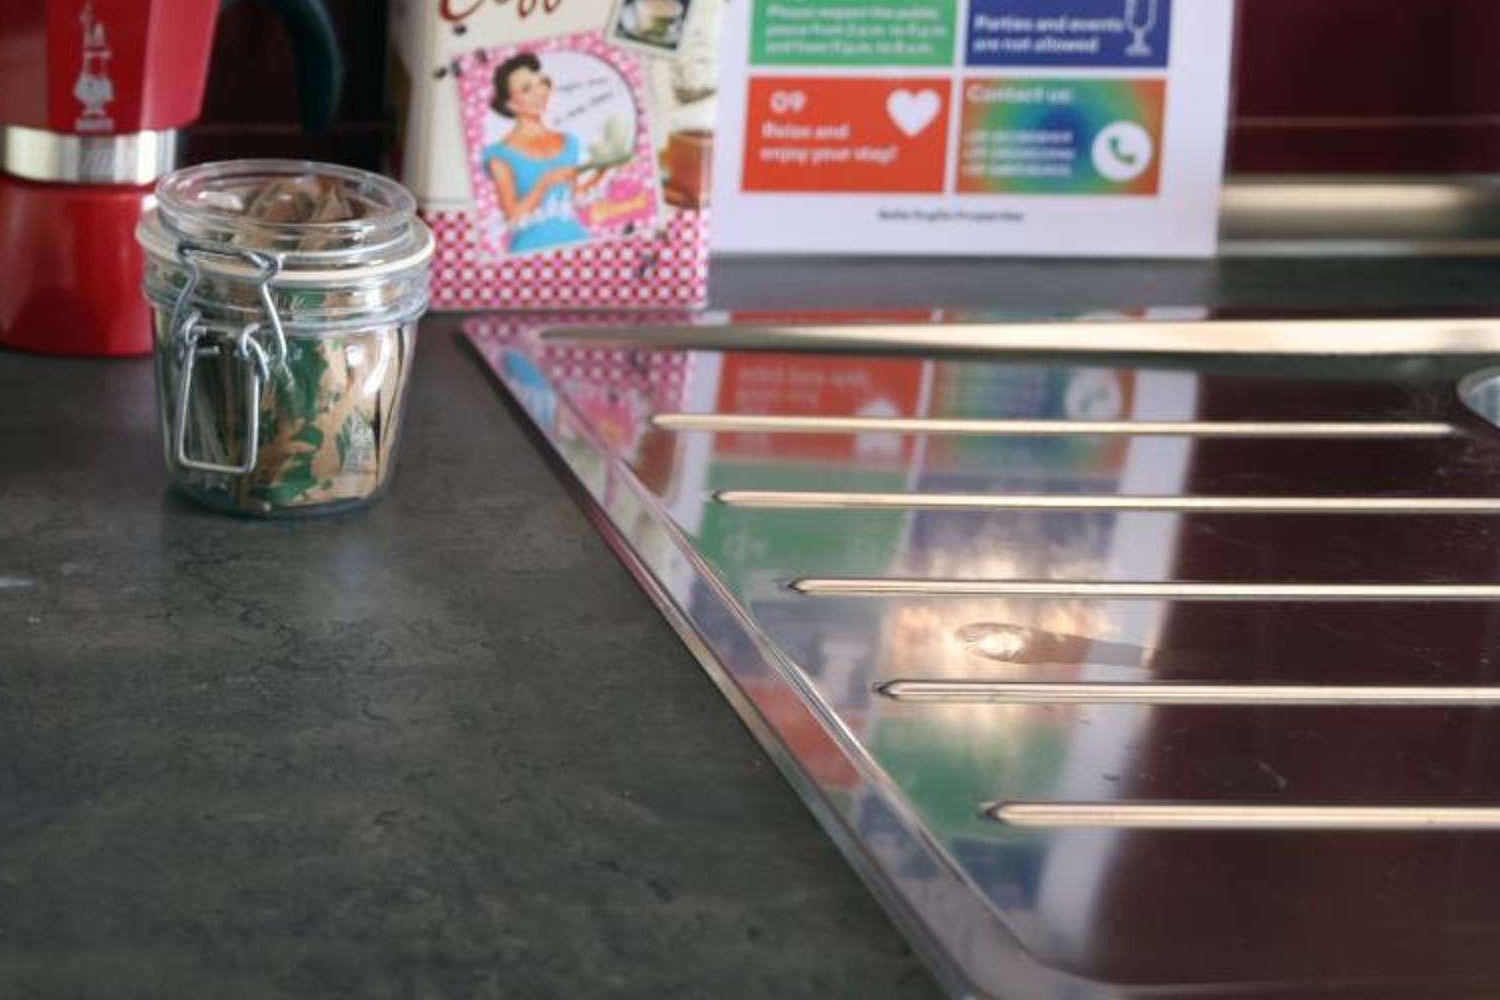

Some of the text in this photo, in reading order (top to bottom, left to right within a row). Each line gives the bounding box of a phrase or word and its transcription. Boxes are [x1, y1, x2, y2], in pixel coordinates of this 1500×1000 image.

[973, 12, 1124, 34] Parties and events
[972, 39, 999, 54] are
[1001, 37, 1031, 54] not
[769, 89, 807, 115] 09
[964, 83, 1043, 104] Contact
[761, 121, 851, 140] Relax and
[759, 146, 808, 167] enjoy
[811, 148, 851, 167] your
